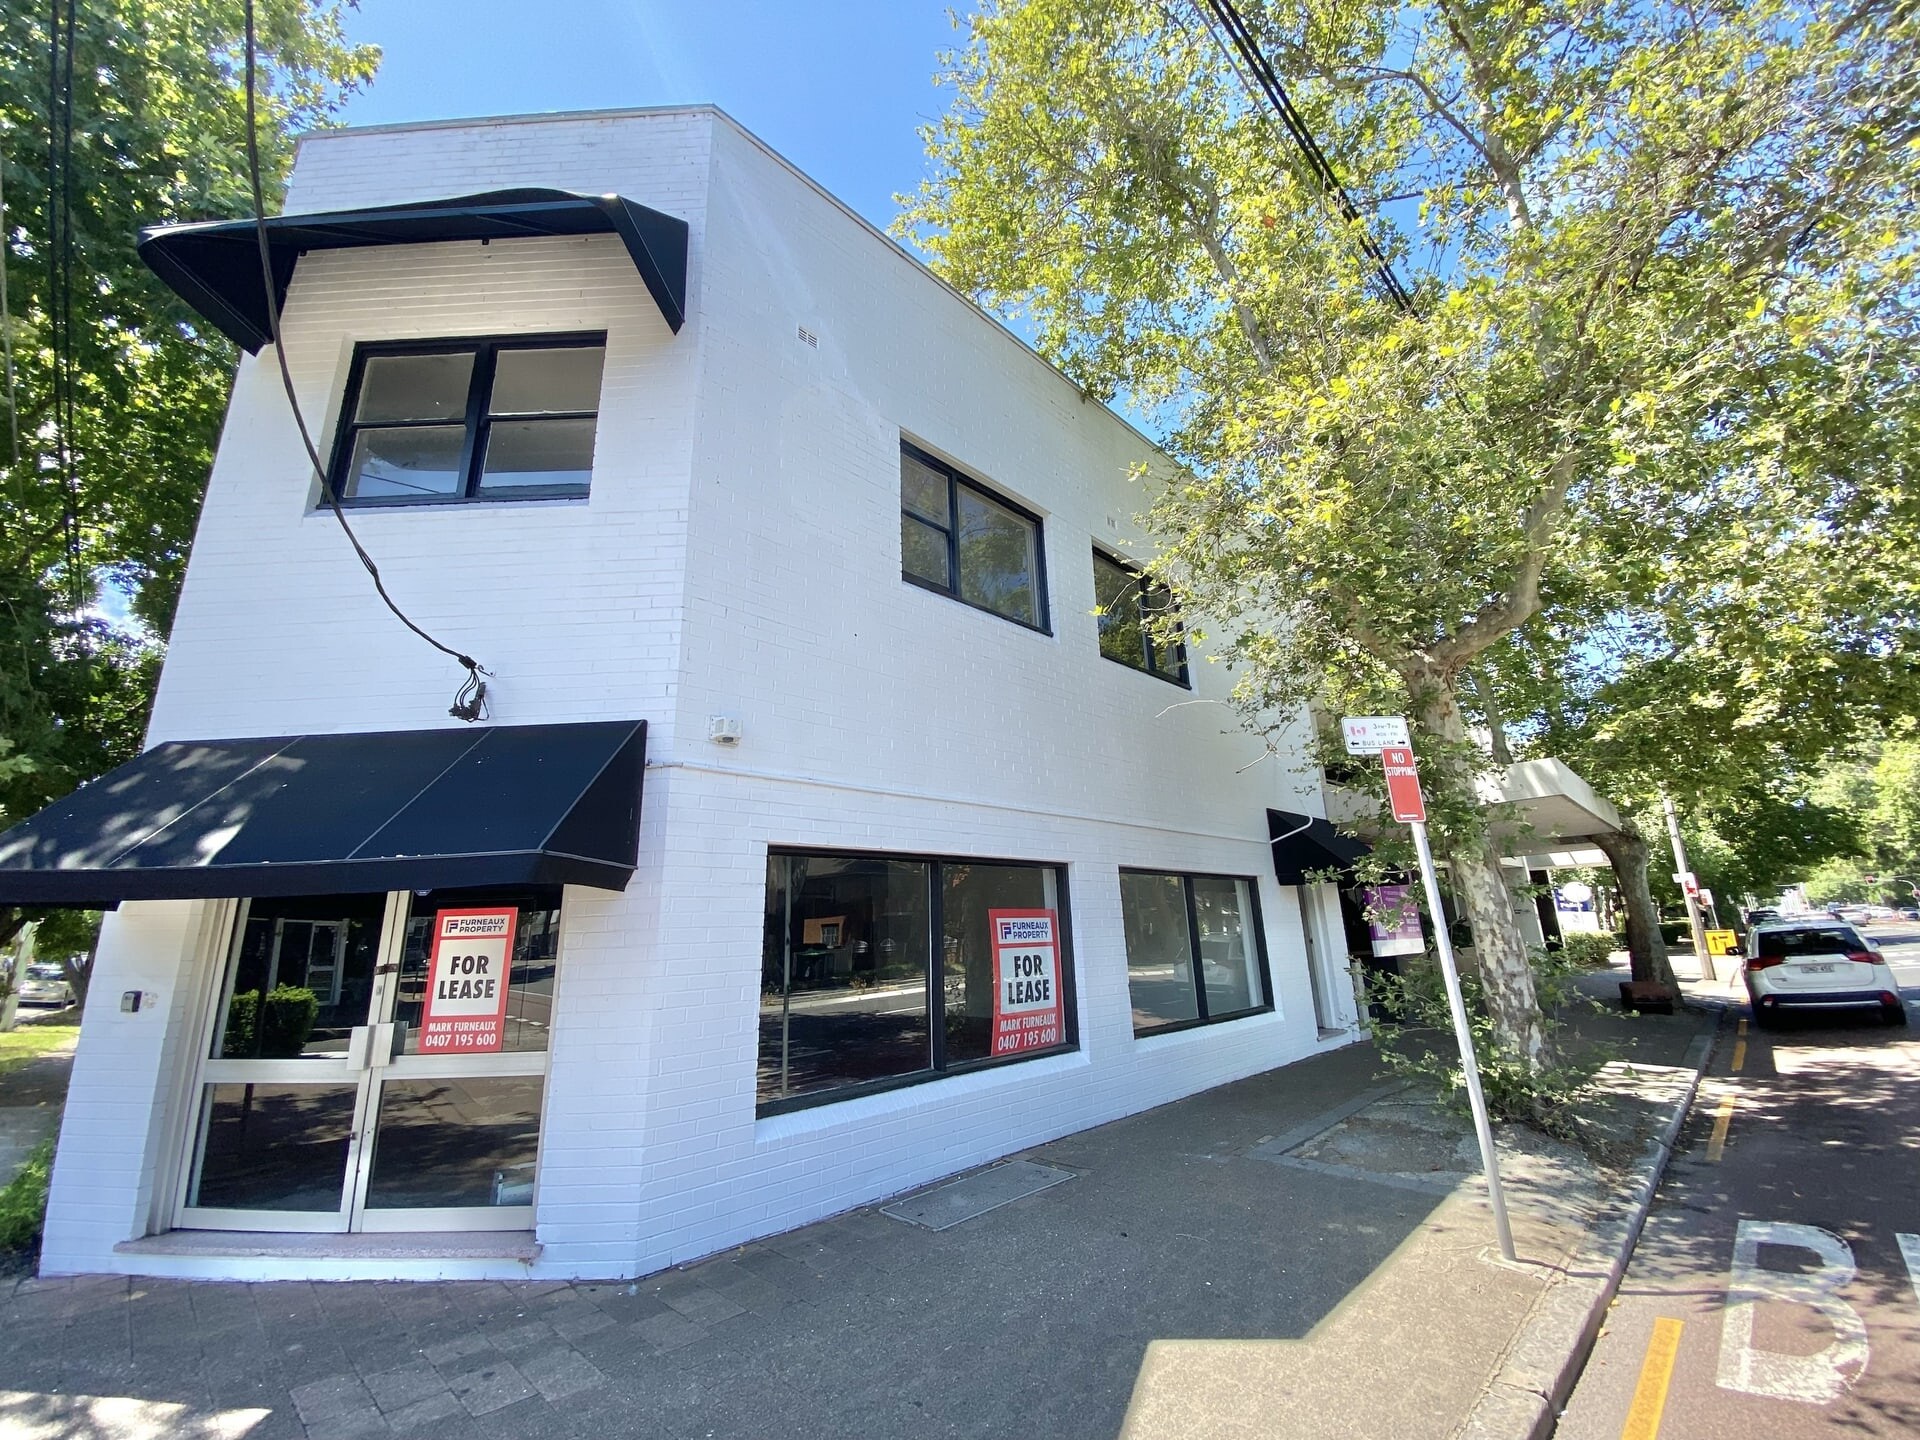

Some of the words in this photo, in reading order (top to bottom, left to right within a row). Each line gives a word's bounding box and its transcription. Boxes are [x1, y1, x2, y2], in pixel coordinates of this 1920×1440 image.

[1391, 752, 1404, 764] NO
[1386, 767, 1416, 776] STOPPING
[460, 918, 505, 926] FURNEAUX
[1012, 921, 1048, 930] FURNEAUX
[1013, 930, 1048, 939] PROPERTY
[450, 956, 489, 975] FOR
[1014, 955, 1043, 977] FOR
[438, 979, 495, 999] LEASE
[1008, 979, 1050, 1005] LEASE
[428, 1022, 452, 1032] MARK
[454, 1021, 496, 1031] FURNEAUX
[1000, 1018, 1021, 1032] MARK
[1023, 1013, 1056, 1029] FURNEAUX
[426, 1034, 451, 1046] 0407
[455, 1034, 473, 1046] 195
[476, 1033, 496, 1045] 600
[998, 1033, 1020, 1050] 0407
[1023, 1031, 1038, 1046] 195
[1040, 1028, 1056, 1044] 600
[1716, 1220, 1920, 1405] B
